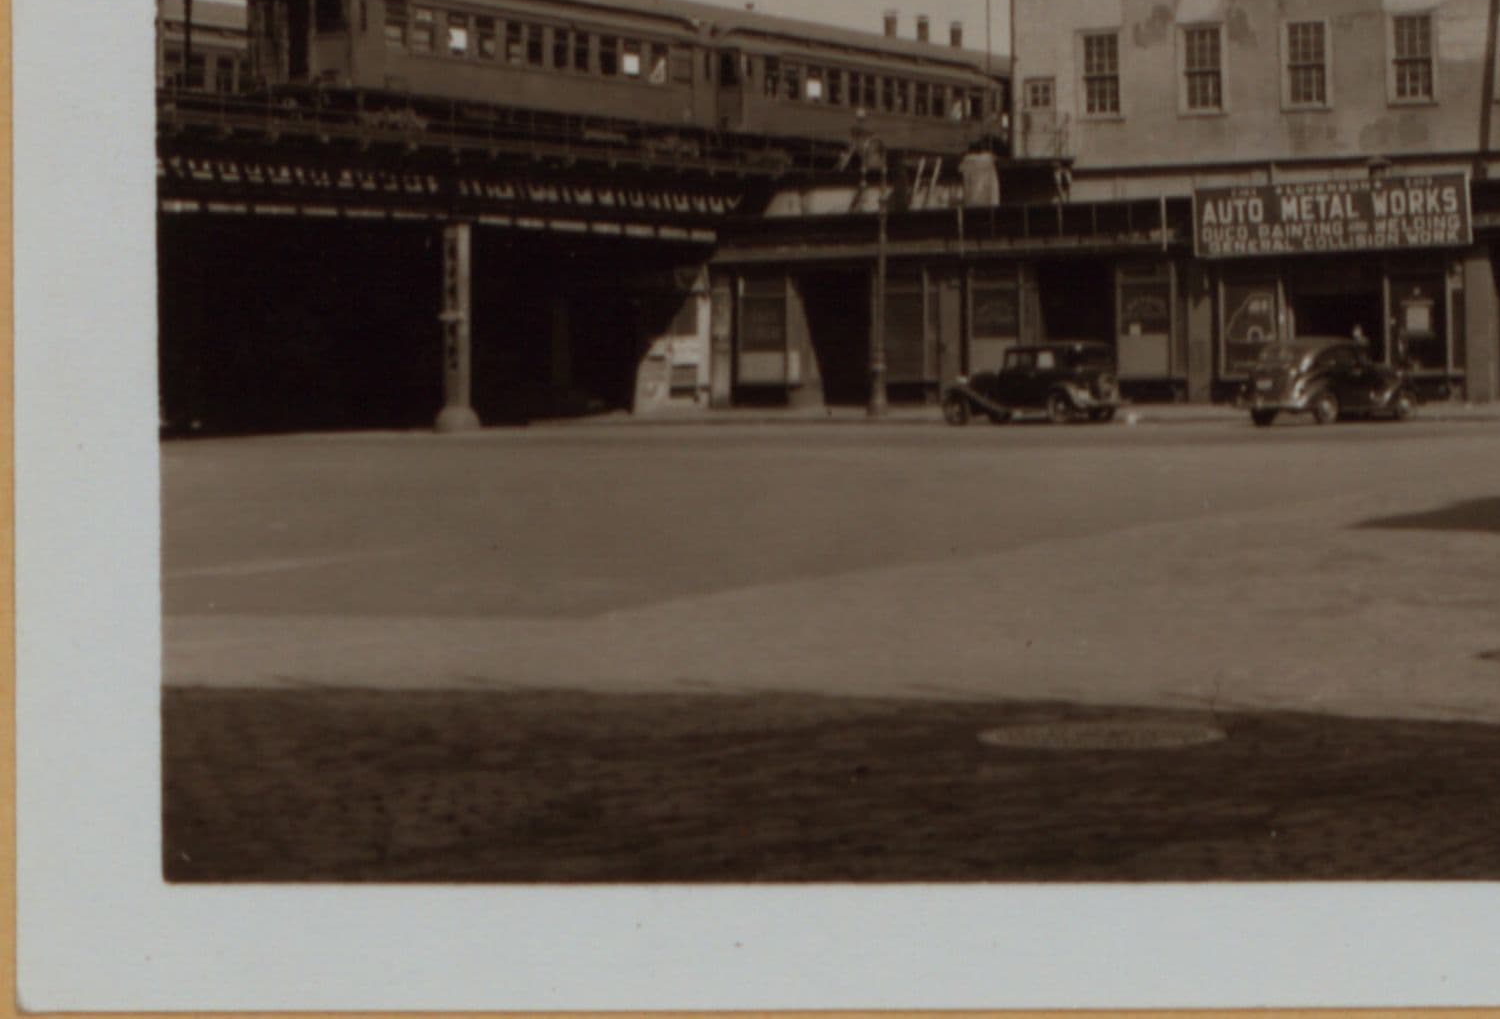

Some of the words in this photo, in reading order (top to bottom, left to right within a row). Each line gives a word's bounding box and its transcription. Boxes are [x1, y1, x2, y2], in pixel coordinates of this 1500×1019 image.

[1202, 198, 1264, 225] AUTO
[1281, 192, 1359, 222] METAL
[1371, 186, 1457, 218] WORKS
[1258, 219, 1343, 239] PAINTING
[1375, 212, 1460, 233] WELDING
[1208, 238, 1294, 254] GENERAL
[1303, 231, 1399, 252] COLLISION
[1405, 226, 1458, 246] WORK
